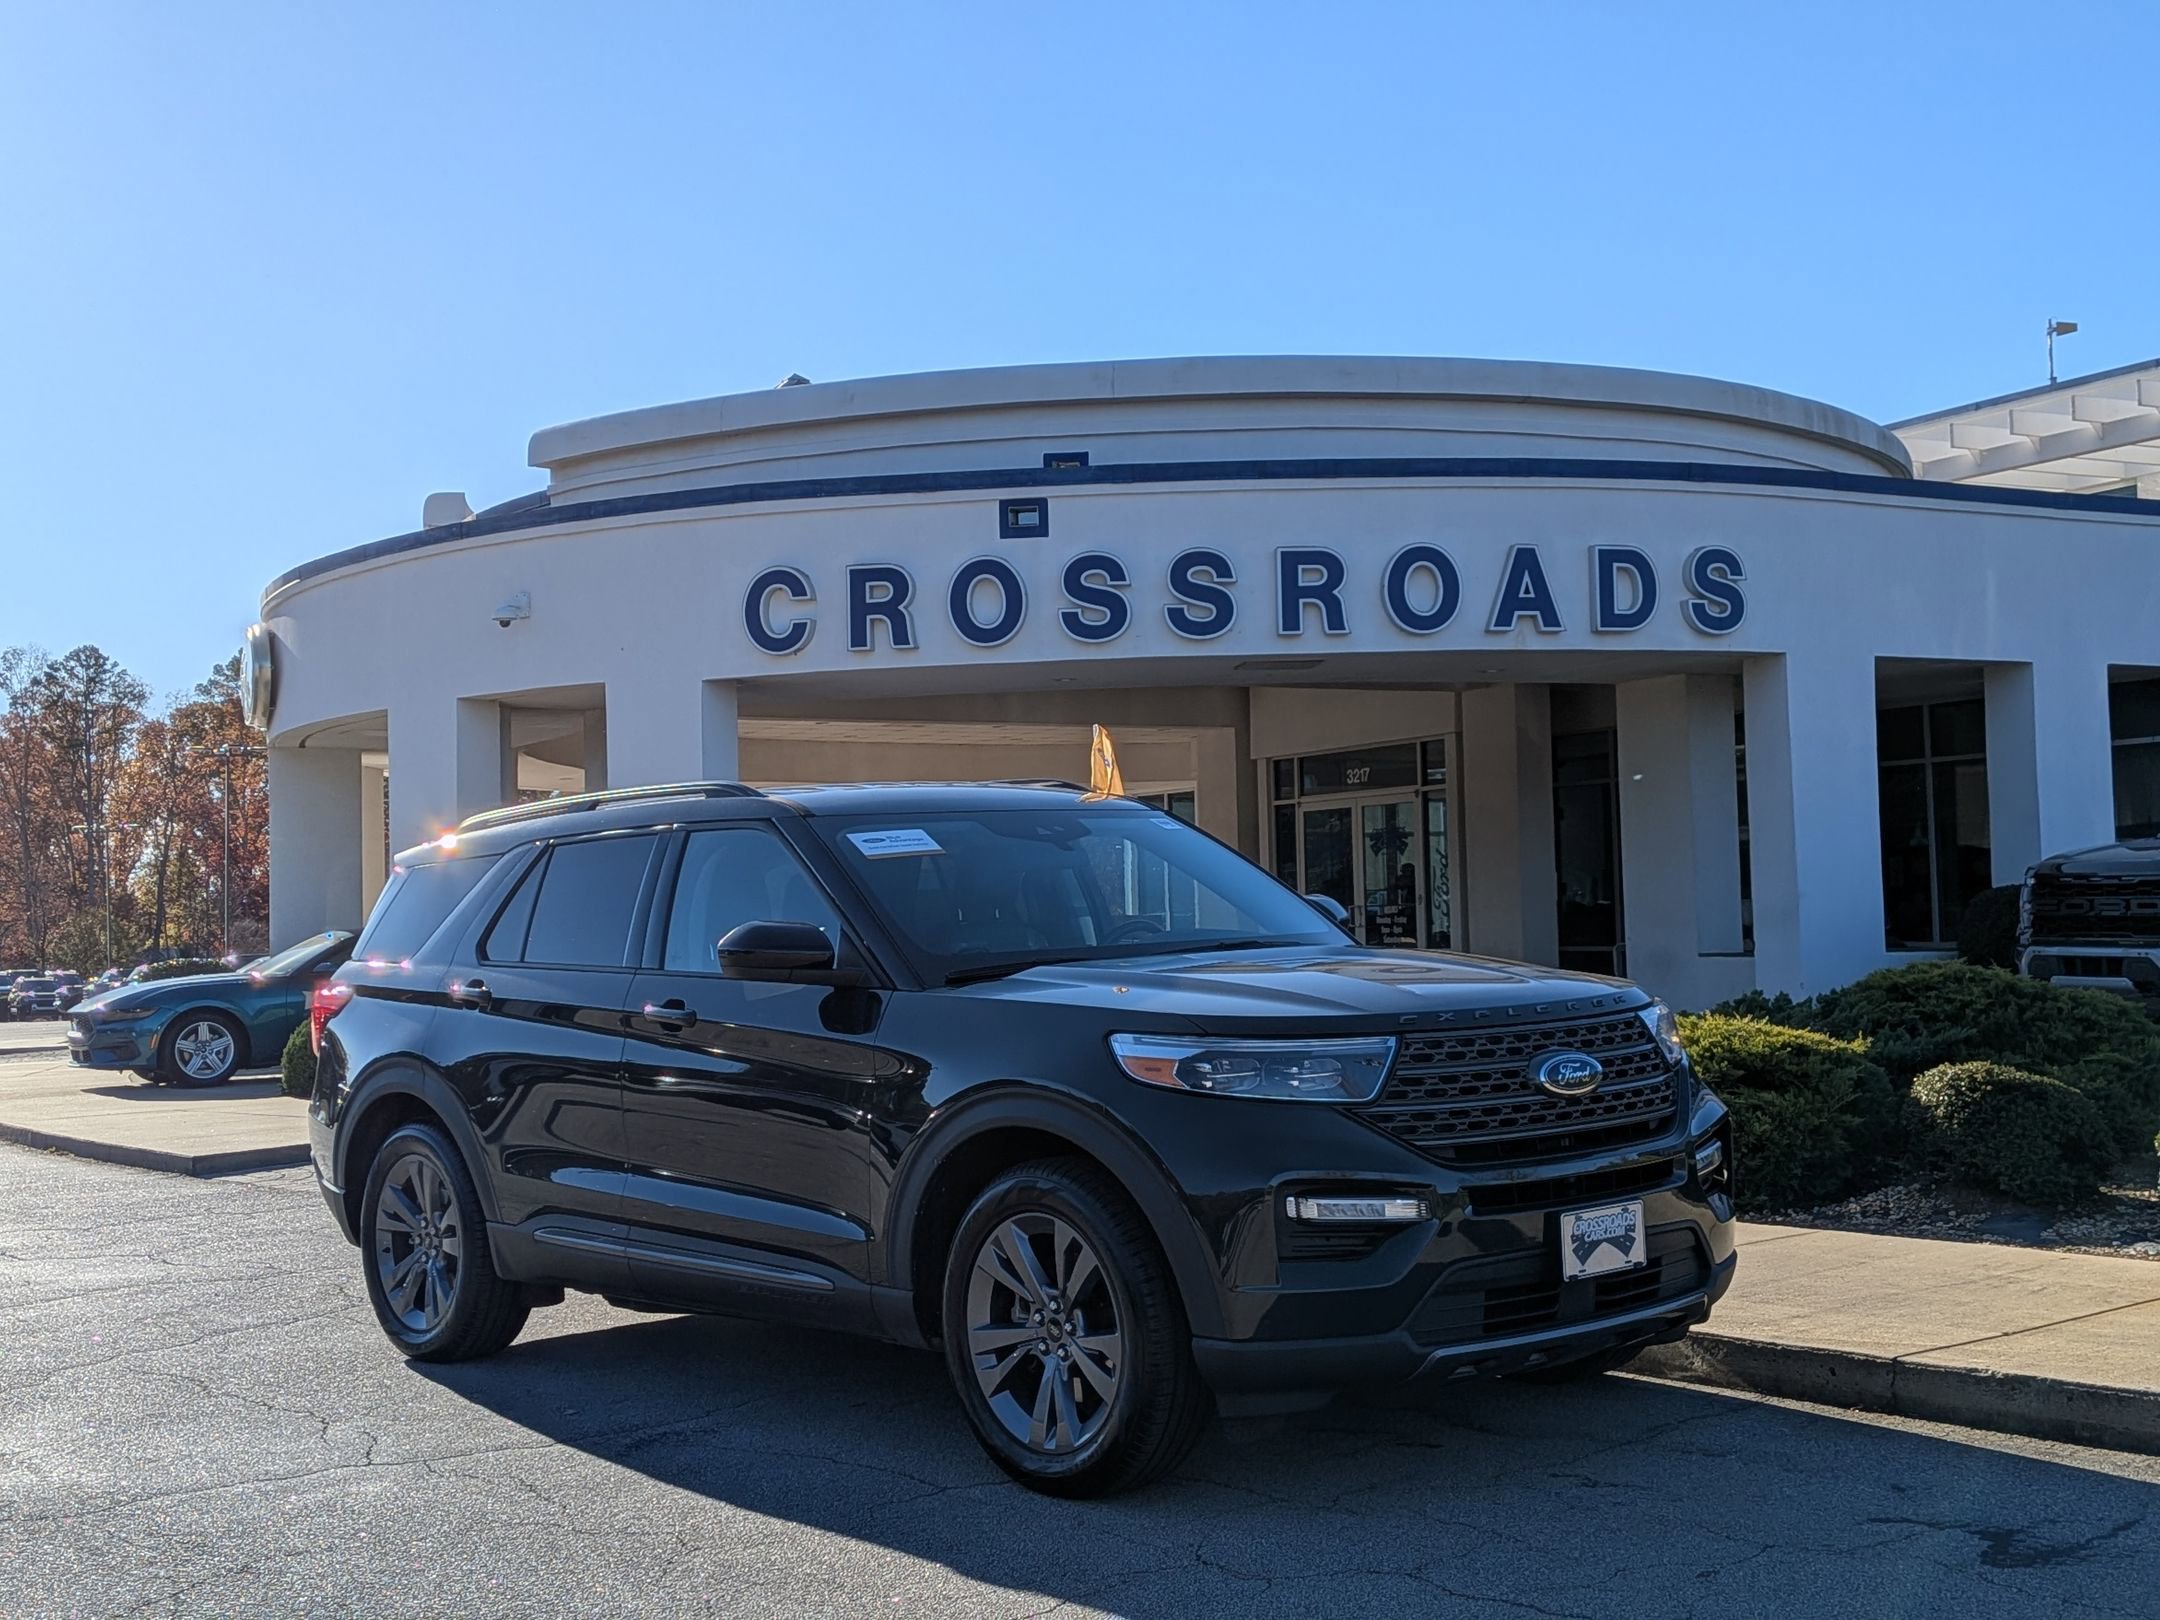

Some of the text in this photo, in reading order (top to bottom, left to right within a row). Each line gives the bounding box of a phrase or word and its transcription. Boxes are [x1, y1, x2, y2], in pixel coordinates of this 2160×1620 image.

[743, 541, 1748, 657] CROSSROADS
[1346, 767, 1370, 784] 3217
[1432, 848, 1450, 918] Ford
[2033, 896, 2160, 916] FORD
[1399, 995, 1626, 1025] EXPLORER
[1558, 1062, 1591, 1086] Ford
[1573, 1211, 1636, 1235] CROSSROADS
[1584, 1226, 1626, 1242] CARS.COM
